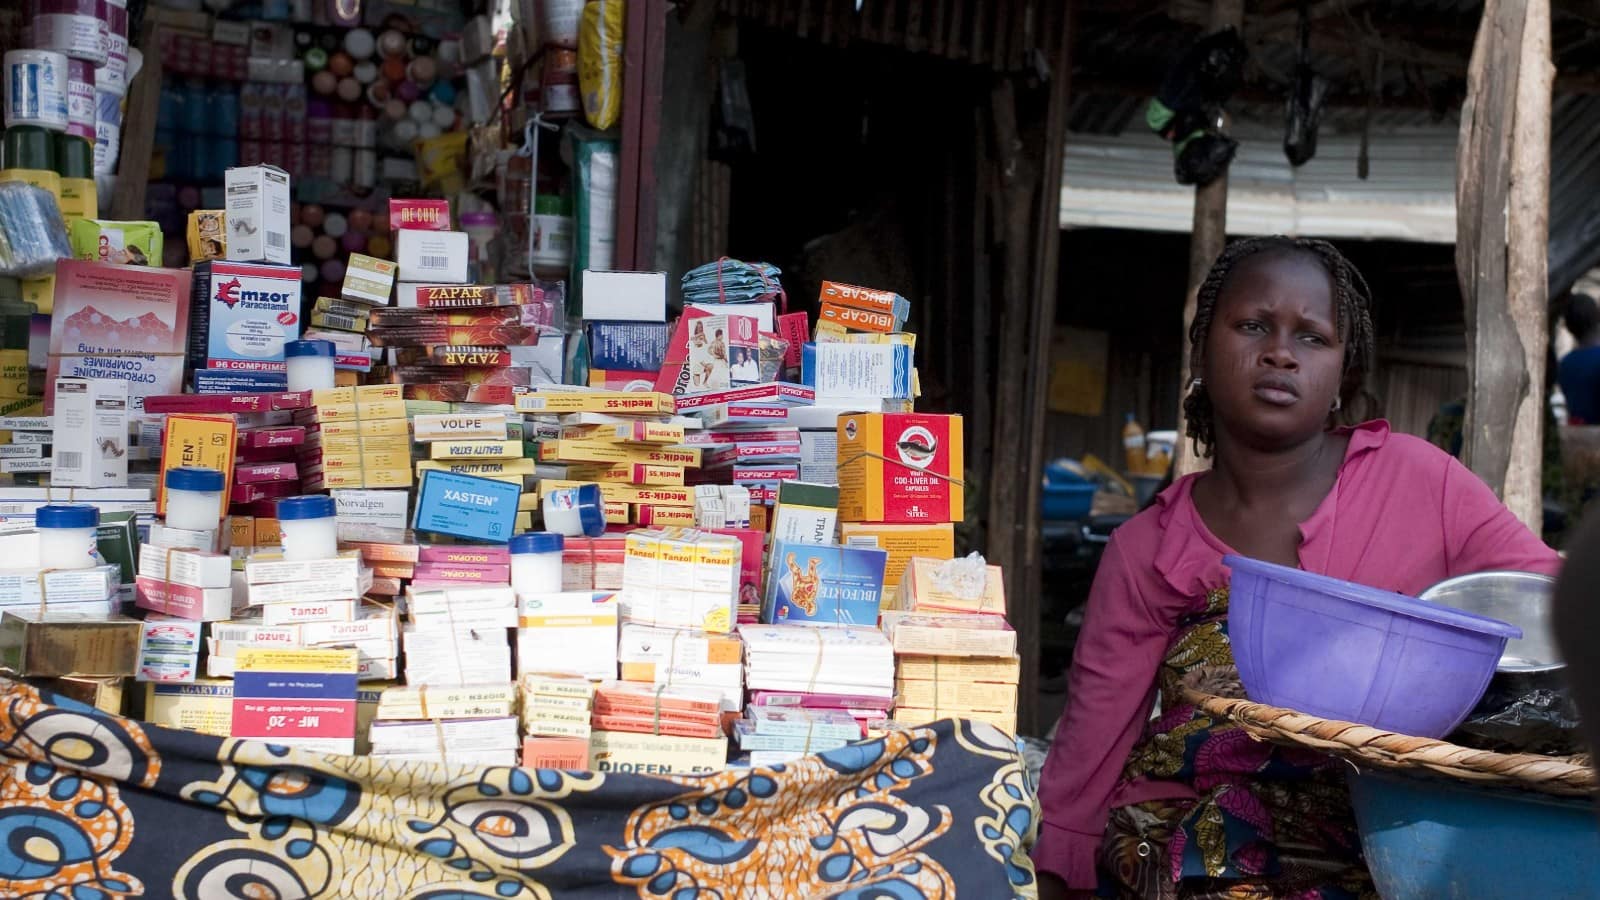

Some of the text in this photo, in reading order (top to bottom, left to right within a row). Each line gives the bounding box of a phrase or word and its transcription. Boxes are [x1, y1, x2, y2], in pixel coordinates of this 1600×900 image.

[428, 287, 483, 299] ZAPAR
[842, 287, 892, 304] IBUCAP
[241, 301, 289, 311] Paracetamol
[429, 299, 483, 307] PAINKILLER
[841, 309, 892, 327] IBUCAP
[78, 343, 95, 354] mg
[446, 353, 499, 364] ZAPAR
[215, 361, 288, 371] 96 COMPRIME
[73, 367, 156, 383] CYPROHEPTADINE
[607, 399, 653, 407] Medik-SS
[441, 420, 482, 429] VOLPE
[450, 446, 503, 455] REALITY EXTRA
[649, 453, 694, 463] Medik-SS
[451, 464, 503, 473] REALITY EXTRA
[444, 489, 493, 506] XASTEN
[638, 491, 687, 501] Medik-SS
[337, 498, 384, 510] Norvalgen
[629, 548, 655, 559] Tanzol
[663, 553, 692, 563] Tanzol
[700, 556, 730, 565] Tanzol
[290, 607, 328, 616] Tanzol
[331, 624, 368, 633] Tanzol
[254, 633, 292, 642] Tanzol
[269, 715, 287, 726] 20
[297, 715, 319, 727] MF
[598, 761, 672, 774] DIOFEN
